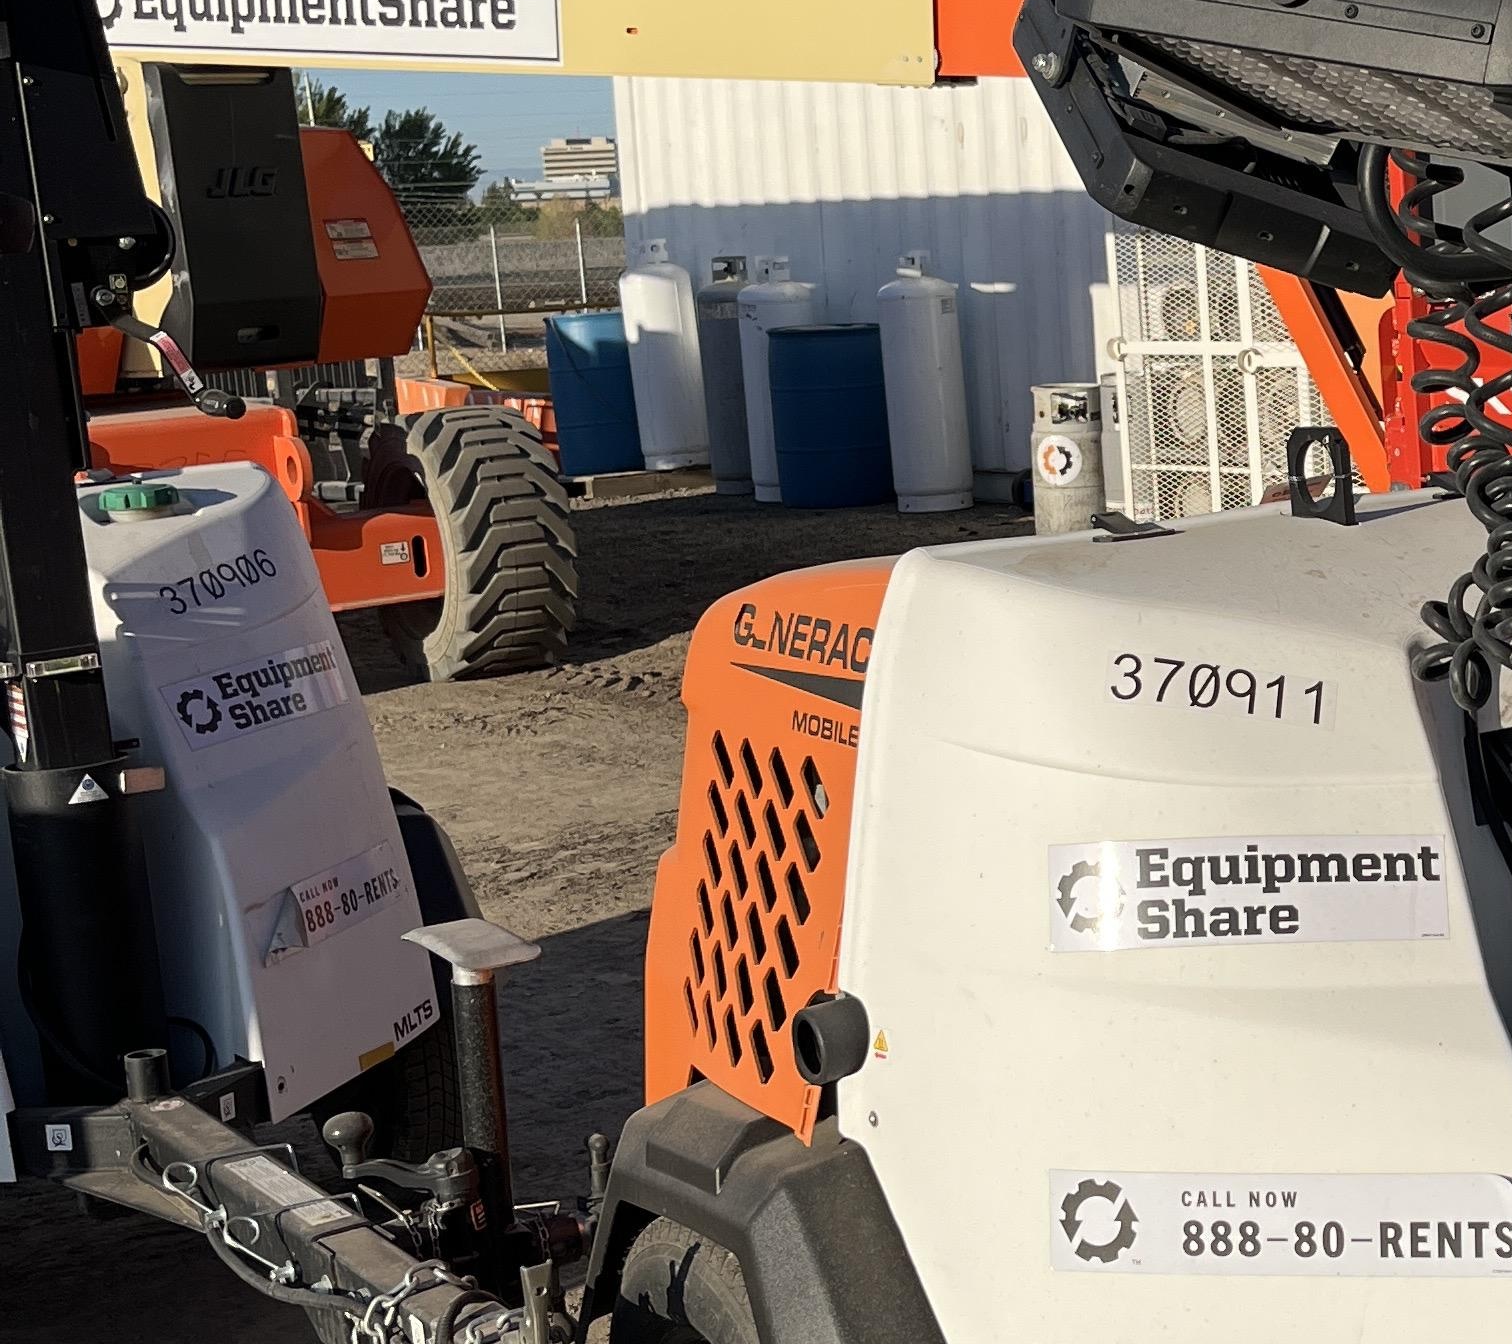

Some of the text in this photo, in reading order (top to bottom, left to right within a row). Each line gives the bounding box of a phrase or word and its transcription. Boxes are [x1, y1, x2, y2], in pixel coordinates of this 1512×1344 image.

[207, 167, 278, 199] JLG
[159, 548, 277, 615] 370906
[212, 646, 337, 700] Equipment
[1110, 652, 1325, 725] 370911
[228, 691, 308, 731] Share
[791, 709, 860, 748] MOBILE
[299, 876, 339, 904] CALL NOW
[1135, 844, 1441, 896] Equipment
[305, 867, 400, 933] 888-80-RENTS
[1136, 898, 1300, 940] Share
[393, 998, 434, 1042] MLTS
[1180, 1190, 1299, 1209] CALL NOW
